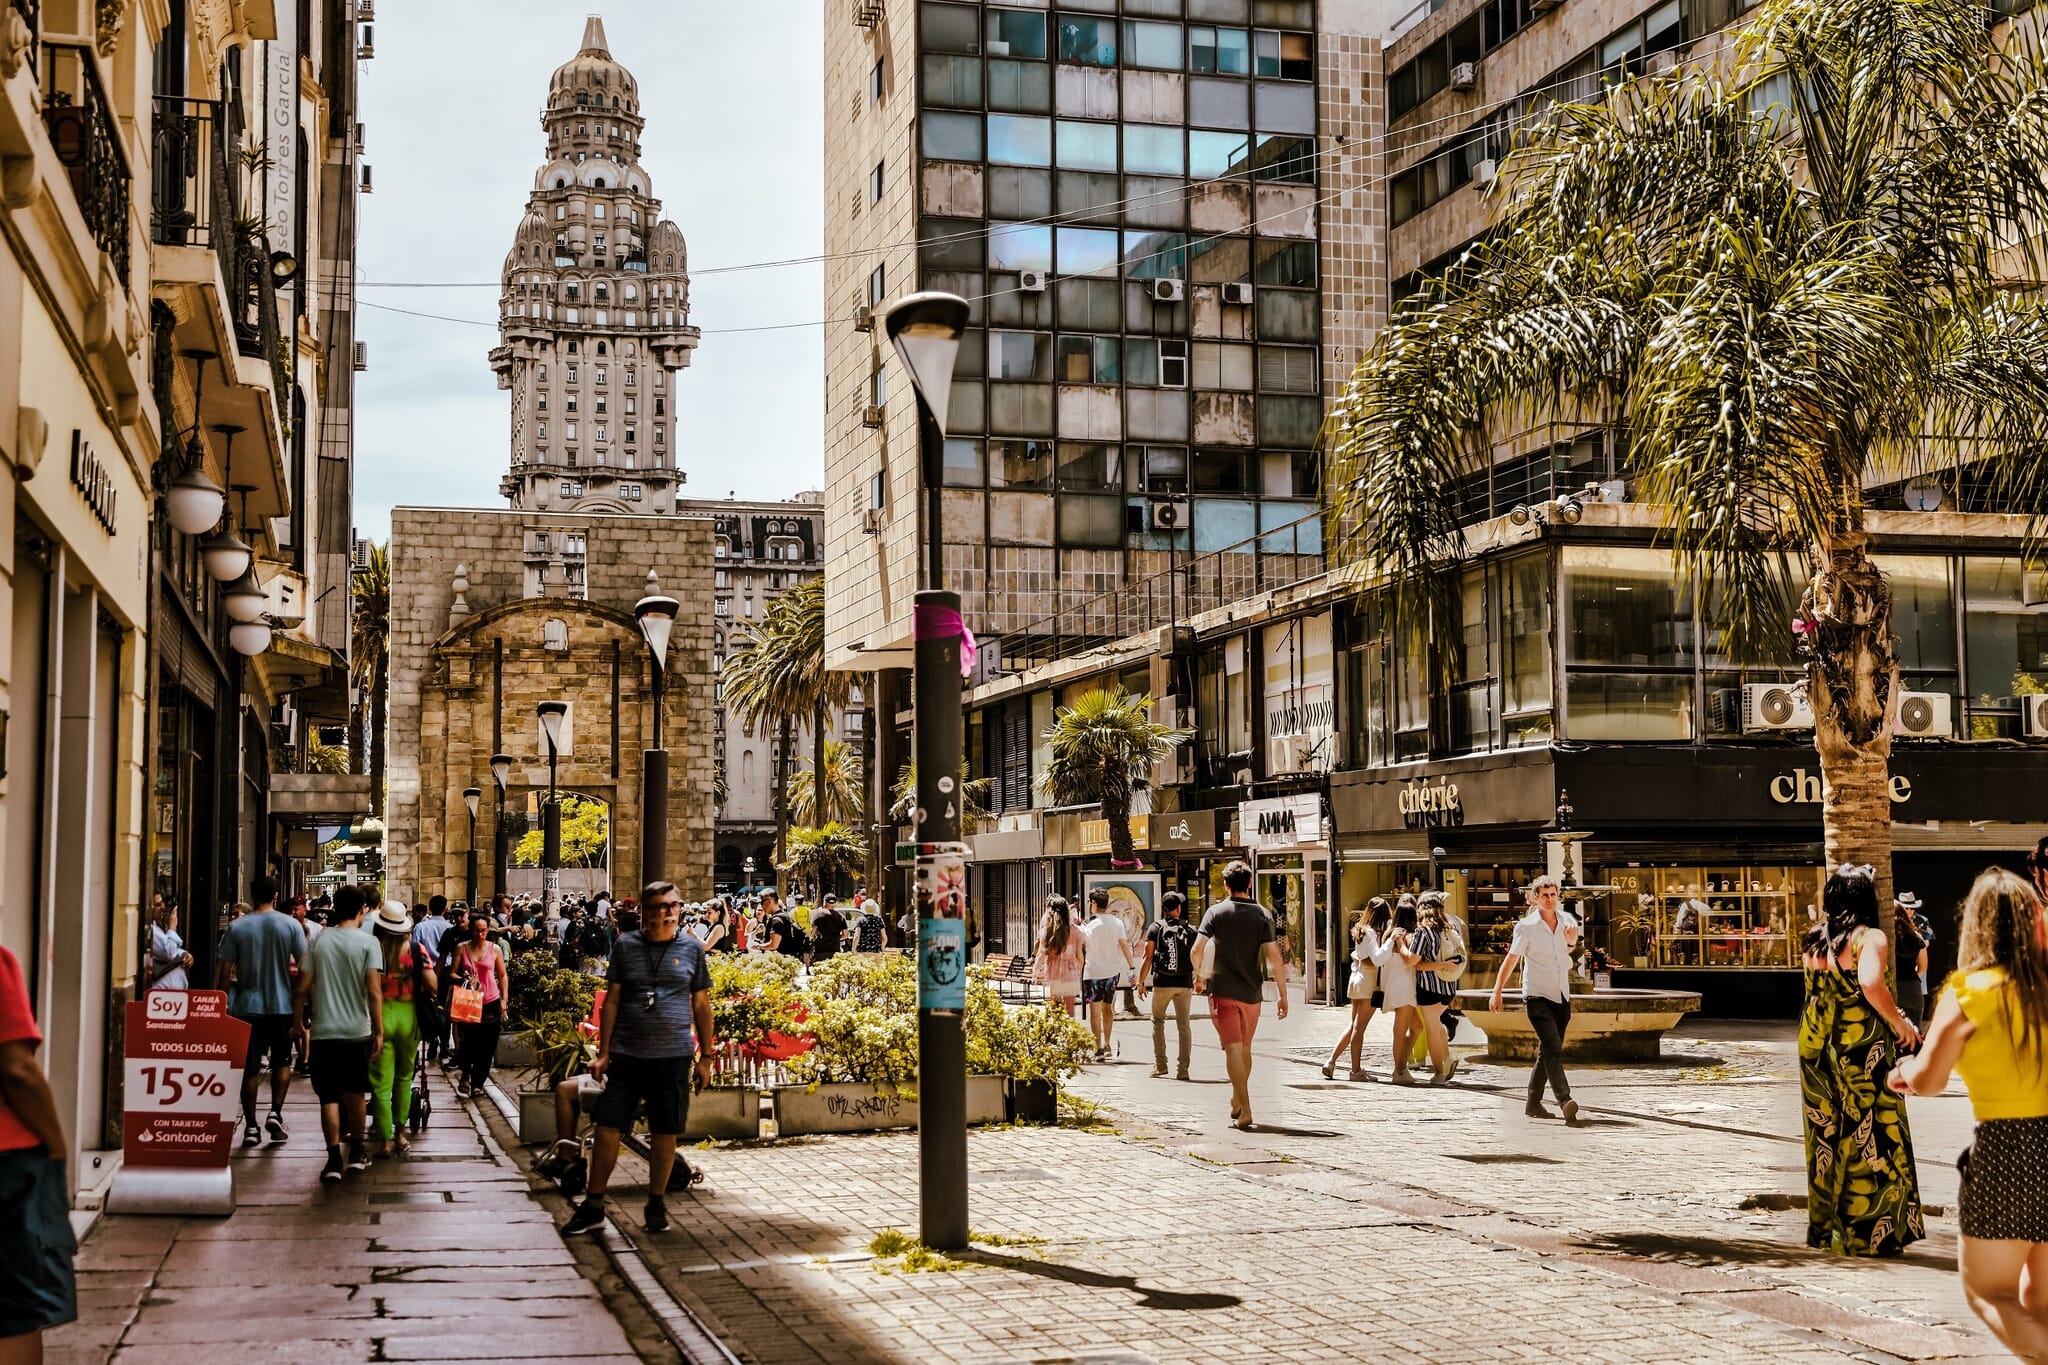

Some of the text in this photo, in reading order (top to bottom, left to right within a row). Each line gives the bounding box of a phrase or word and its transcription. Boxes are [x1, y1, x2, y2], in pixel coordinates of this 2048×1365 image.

[273, 55, 290, 127] García
[273, 134, 290, 204] Torres
[1398, 775, 1459, 814] chérie
[1770, 768, 1912, 803] che
[1258, 809, 1296, 835] AMMA
[1610, 876, 1637, 889] 676
[1167, 936, 1176, 970] Reebok
[152, 997, 183, 1016] Soy
[196, 1003, 215, 1012] AQUÍ
[145, 1021, 187, 1030] Santander
[150, 1042, 228, 1053] TODOS LOS DÍAS
[140, 1066, 226, 1106] 15%
[153, 1119, 170, 1127] CON
[155, 1130, 218, 1143] Santander
